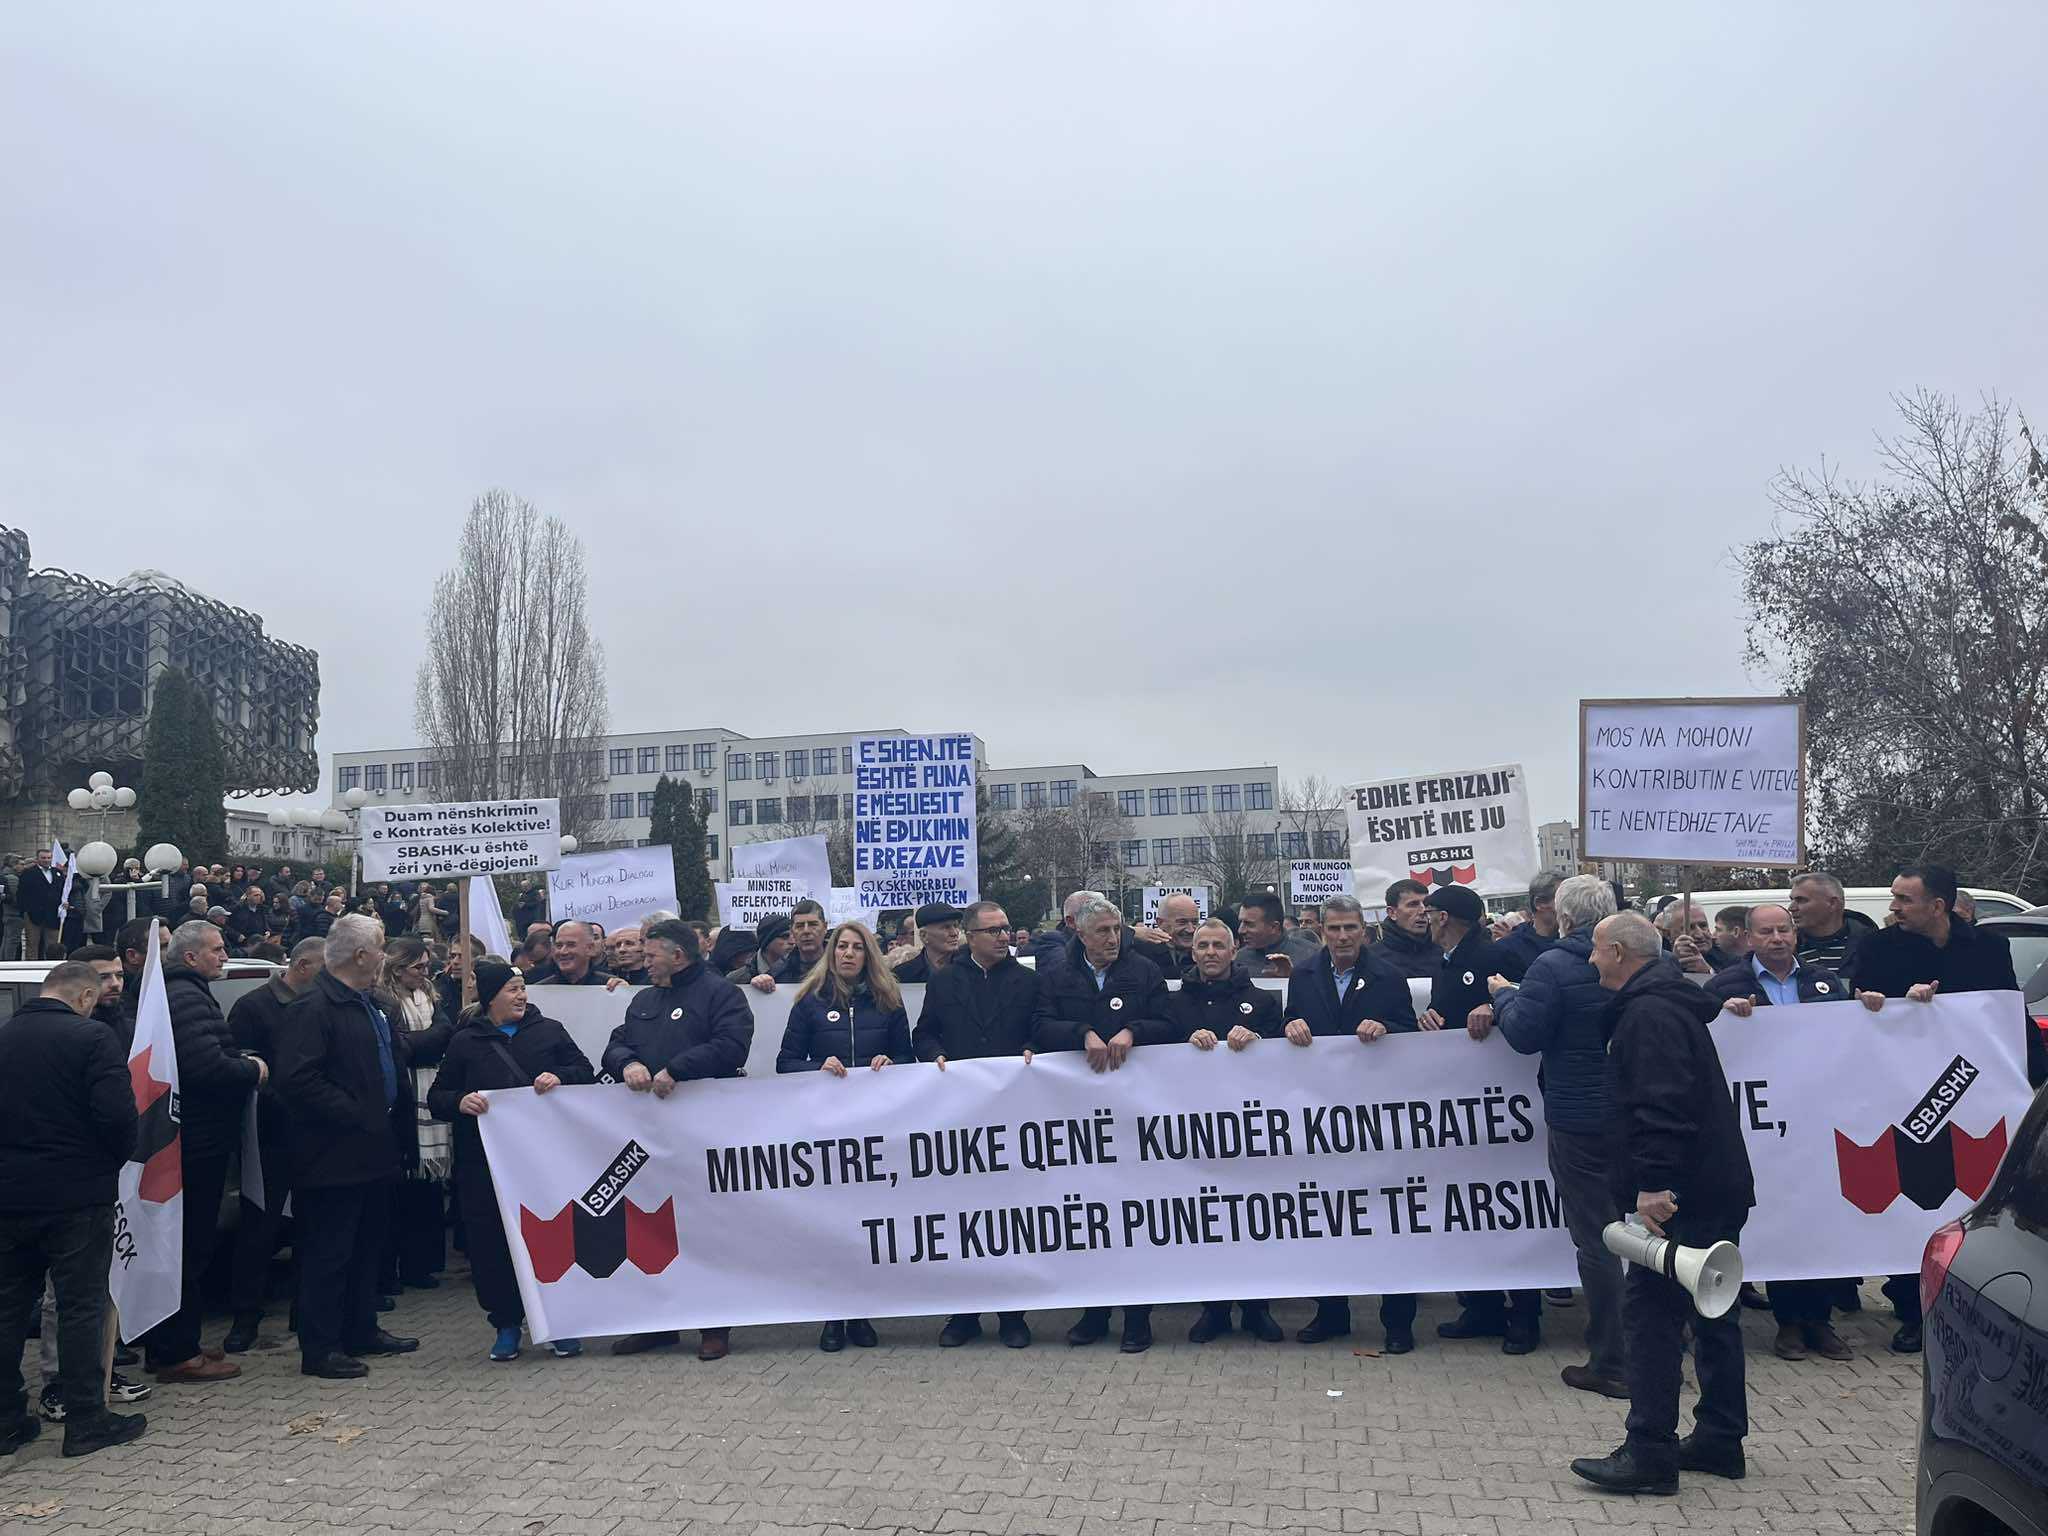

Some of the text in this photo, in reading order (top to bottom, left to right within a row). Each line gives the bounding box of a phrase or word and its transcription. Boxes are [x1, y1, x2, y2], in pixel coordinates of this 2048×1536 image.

[1596, 726, 1753, 747] MOS NA MOHONI
[860, 734, 972, 763] E SHENJTË
[856, 764, 972, 790] ËSHTË PUNA
[1592, 768, 1727, 791] KONTRIBUTIN
[1731, 769, 1744, 790] E
[384, 803, 539, 822] Duam nënshkrimin
[856, 791, 964, 816] E MËSUESIT
[373, 819, 551, 839] e Kontratës Kolektive!
[856, 818, 970, 844] NË EDUKIMIN
[1367, 806, 1506, 843] ËSHTË ME JU
[397, 839, 529, 859] SBASHK-u është
[856, 845, 965, 870] E BREZAVE
[1410, 848, 1472, 863] SBASHK
[389, 855, 539, 876] zëri ynë-dëgjojeni!
[1291, 862, 1351, 870] KUR MUNGON
[1299, 873, 1339, 881] DIALOGU
[748, 880, 791, 892] MINISTRE
[1303, 884, 1343, 892] MUNGON
[1910, 1060, 1975, 1135] SBASHK
[705, 1135, 898, 1193] MINISTRE,
[908, 1124, 1010, 1179] DUKE
[1019, 1108, 1117, 1173] QENË
[1136, 1100, 1293, 1162] KUNDËR
[1303, 1086, 1535, 1155] KONTRATËS
[589, 1144, 646, 1210] SBASHK
[861, 1217, 897, 1265] TI
[909, 1213, 948, 1265] JE
[959, 1193, 1112, 1260] KUNDËR
[1121, 1181, 1369, 1248] PUNËTORËVE
[1380, 1176, 1432, 1235] TË
